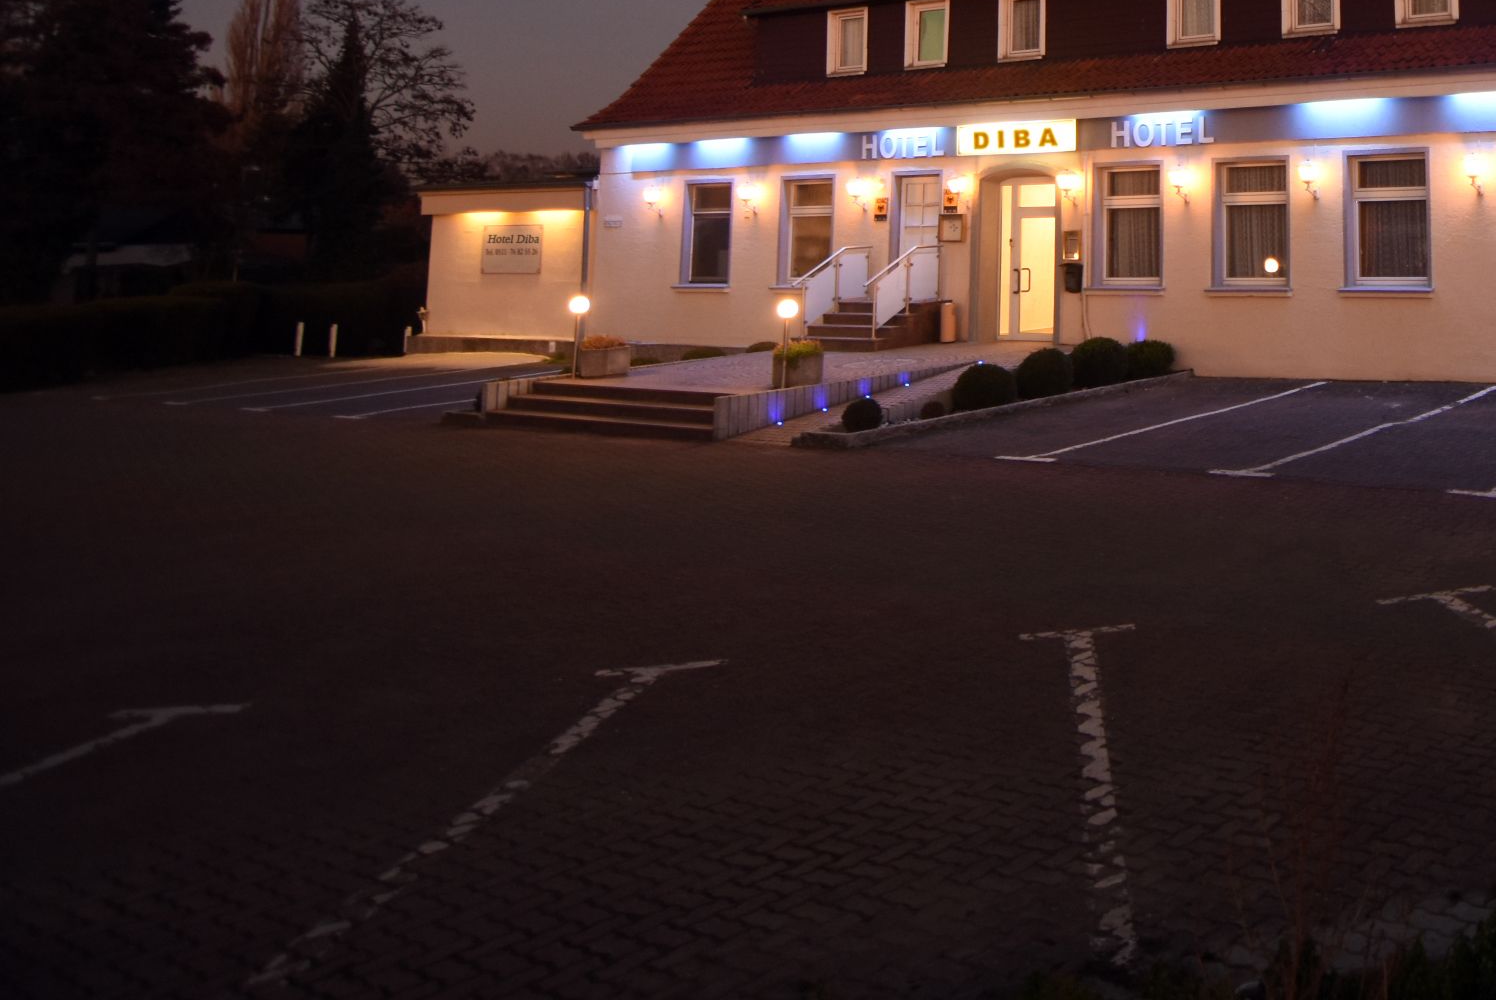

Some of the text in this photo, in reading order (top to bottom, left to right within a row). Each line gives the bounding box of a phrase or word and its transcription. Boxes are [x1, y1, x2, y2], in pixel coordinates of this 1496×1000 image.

[861, 115, 1215, 160] HOTEL DIBA HOTEL
[487, 234, 540, 244] Hotel Diba
